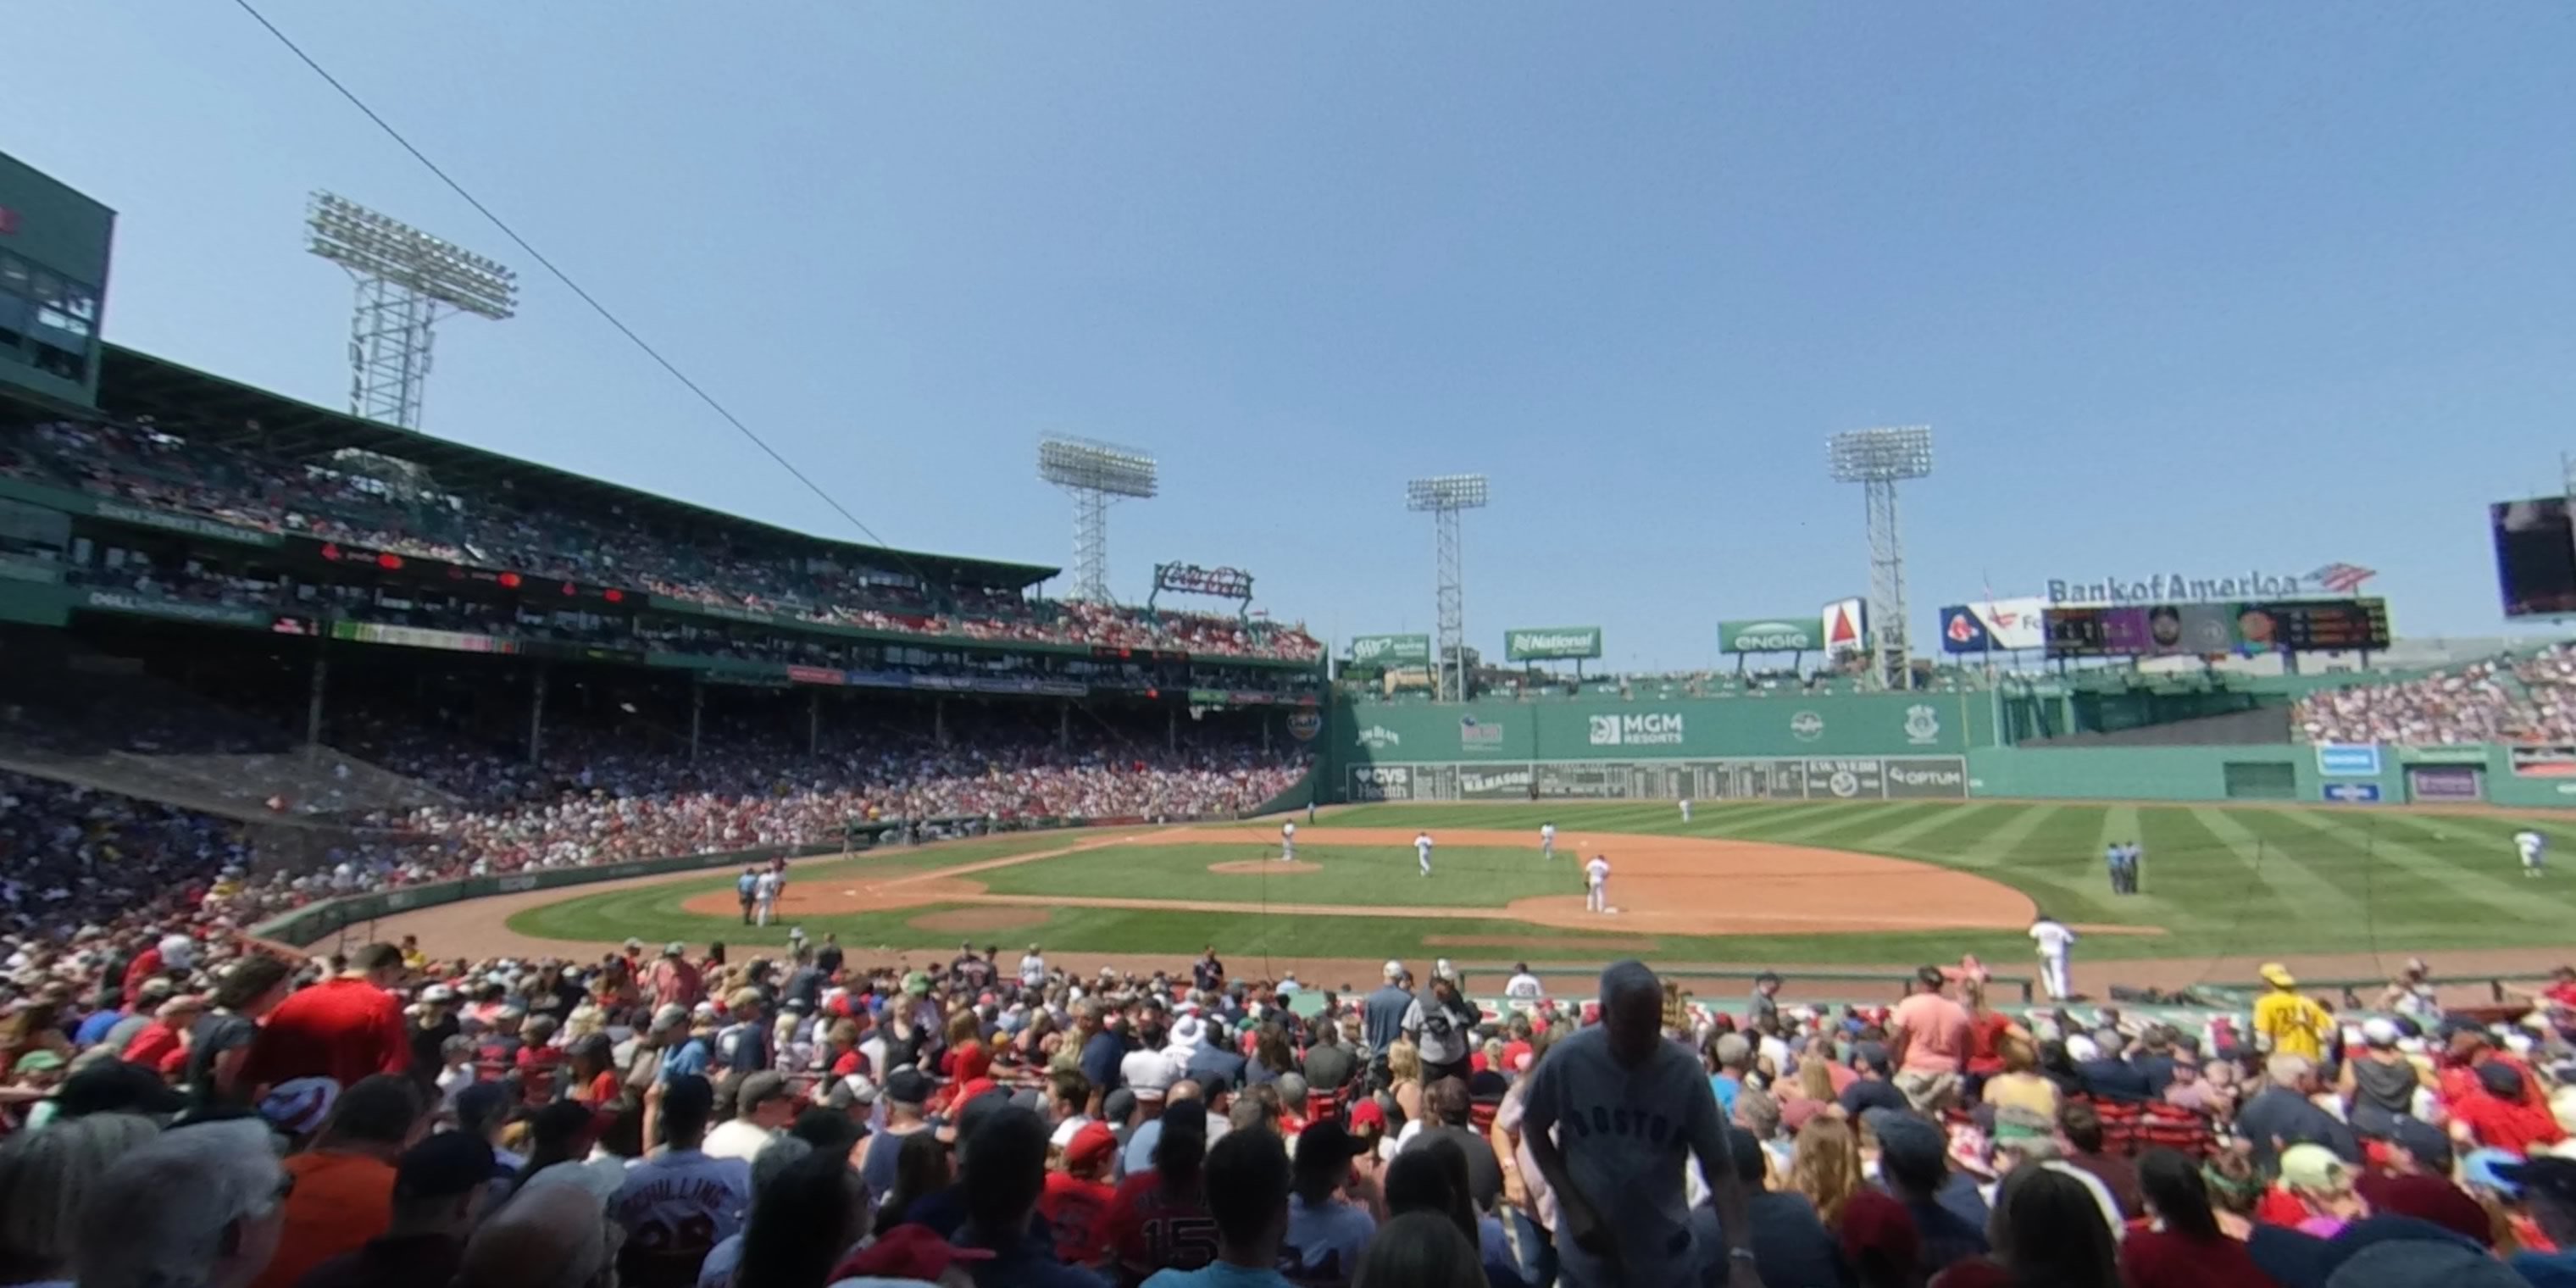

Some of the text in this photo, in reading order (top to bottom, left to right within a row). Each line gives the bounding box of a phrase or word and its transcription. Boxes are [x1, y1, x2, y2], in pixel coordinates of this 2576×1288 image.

[2047, 571, 2299, 603] Bank of America
[1530, 632, 1592, 650] National
[1624, 713, 1682, 733] MGM
[1624, 733, 1683, 744] RESORTS
[1372, 768, 1407, 783] CVS
[1906, 771, 1961, 786] OPTUM
[1357, 783, 1407, 799] Health
[1141, 1218, 1219, 1272] 15
